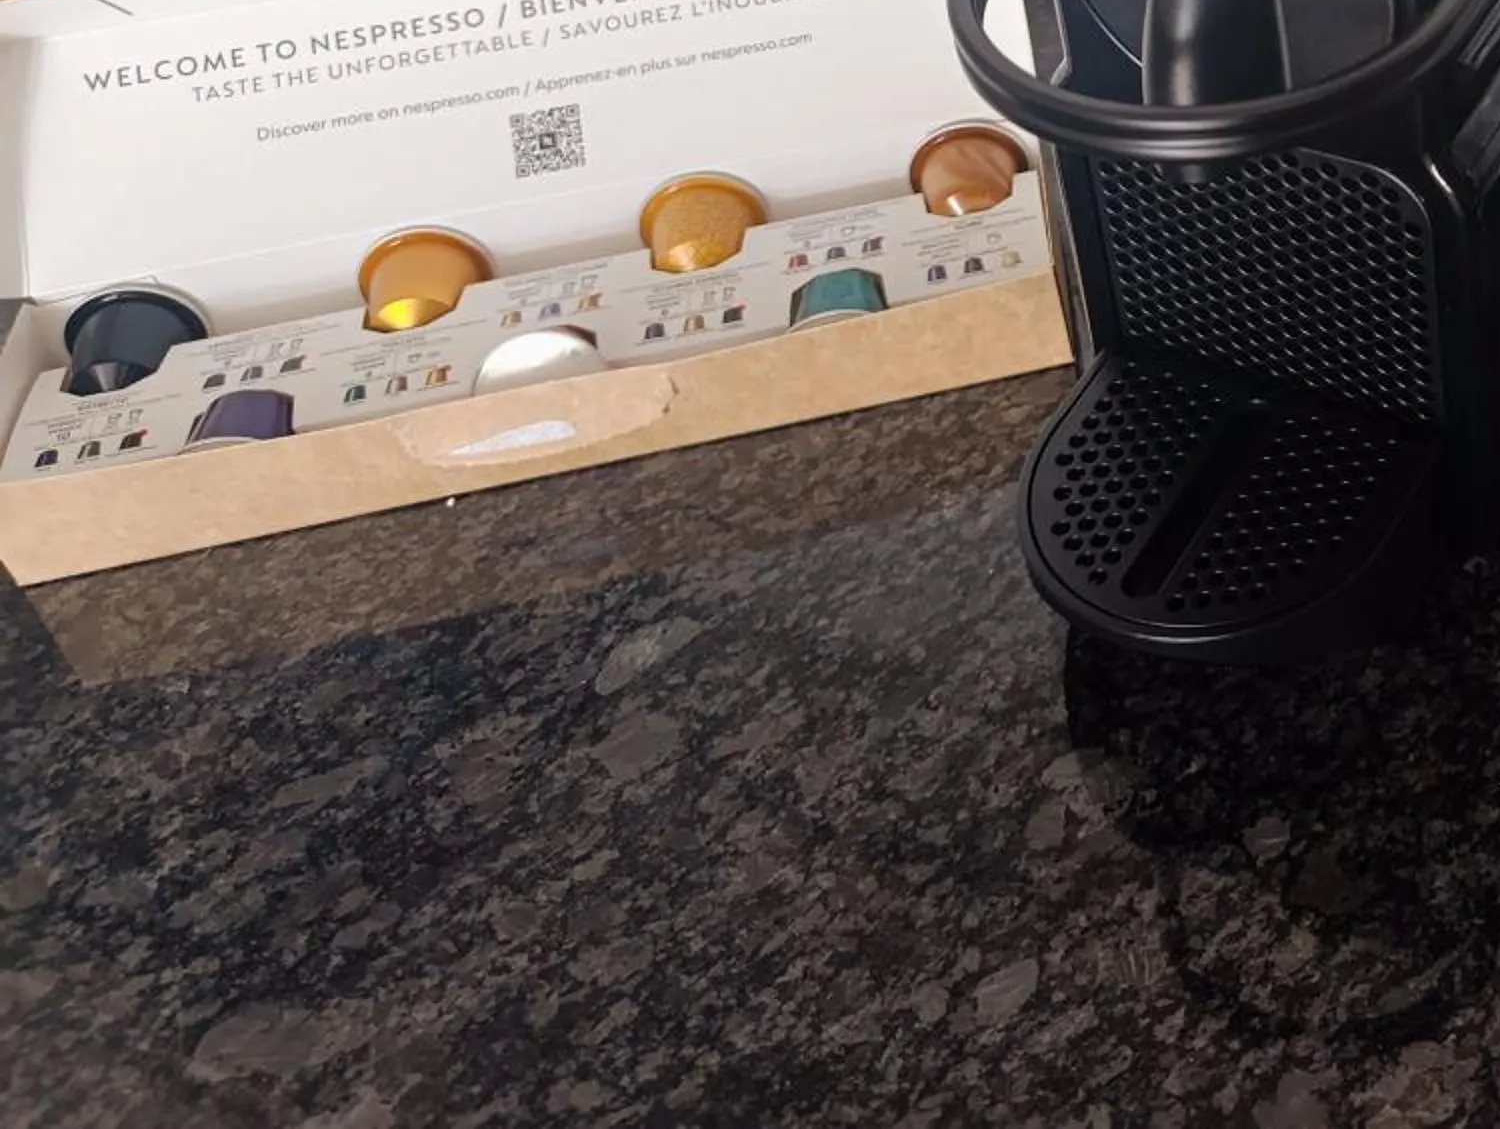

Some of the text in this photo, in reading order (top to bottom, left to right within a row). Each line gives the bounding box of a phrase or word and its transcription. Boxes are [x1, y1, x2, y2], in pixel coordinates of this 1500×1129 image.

[83, 48, 246, 91] WELCOME
[256, 39, 297, 63] TO
[310, 8, 485, 55] NESPRESSO
[498, 2, 508, 29] /
[192, 76, 264, 102] TASTE
[273, 65, 318, 88] THE
[328, 29, 534, 80] UNFORGETTABLE
[542, 27, 550, 48] /
[560, 3, 682, 40] SAVOUREZ
[256, 119, 326, 142] Discover
[331, 111, 374, 127] more
[378, 105, 399, 121] on
[403, 84, 520, 114] nespresso.com
[534, 64, 637, 94] Apprenez-en
[640, 56, 672, 77] plus
[675, 53, 698, 67] sur
[701, 32, 813, 62] nespresso.com
